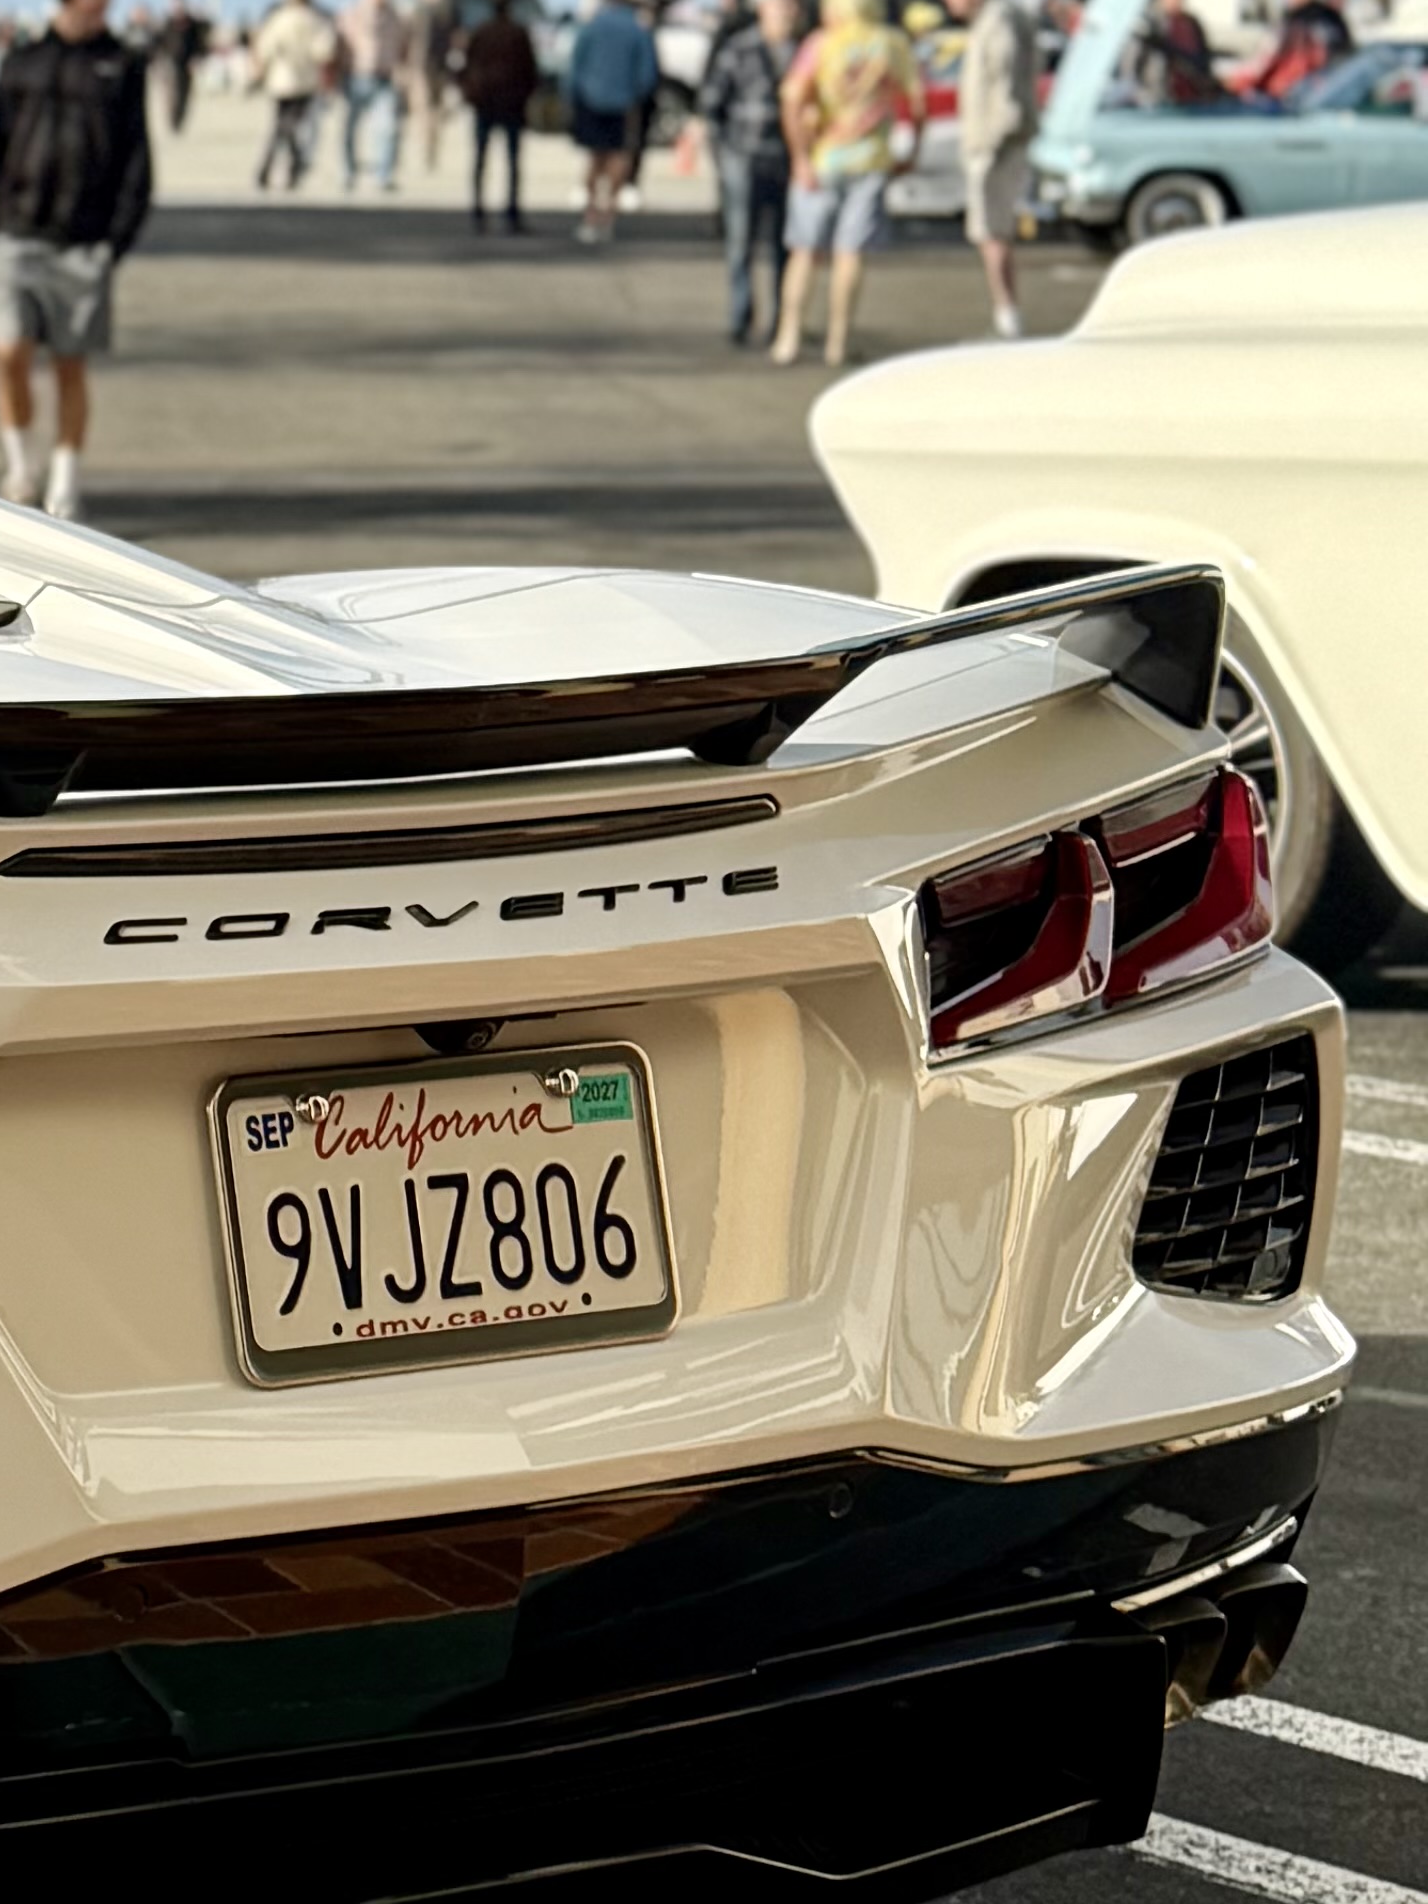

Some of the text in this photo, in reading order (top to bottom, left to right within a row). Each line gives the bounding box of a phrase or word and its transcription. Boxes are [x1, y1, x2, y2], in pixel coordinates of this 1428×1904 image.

[102, 865, 779, 946] CORVETTE
[245, 1110, 295, 1152] SEP
[314, 1086, 574, 1170] California
[581, 1078, 619, 1103] 2027
[266, 1154, 637, 1317] 9VJZ806
